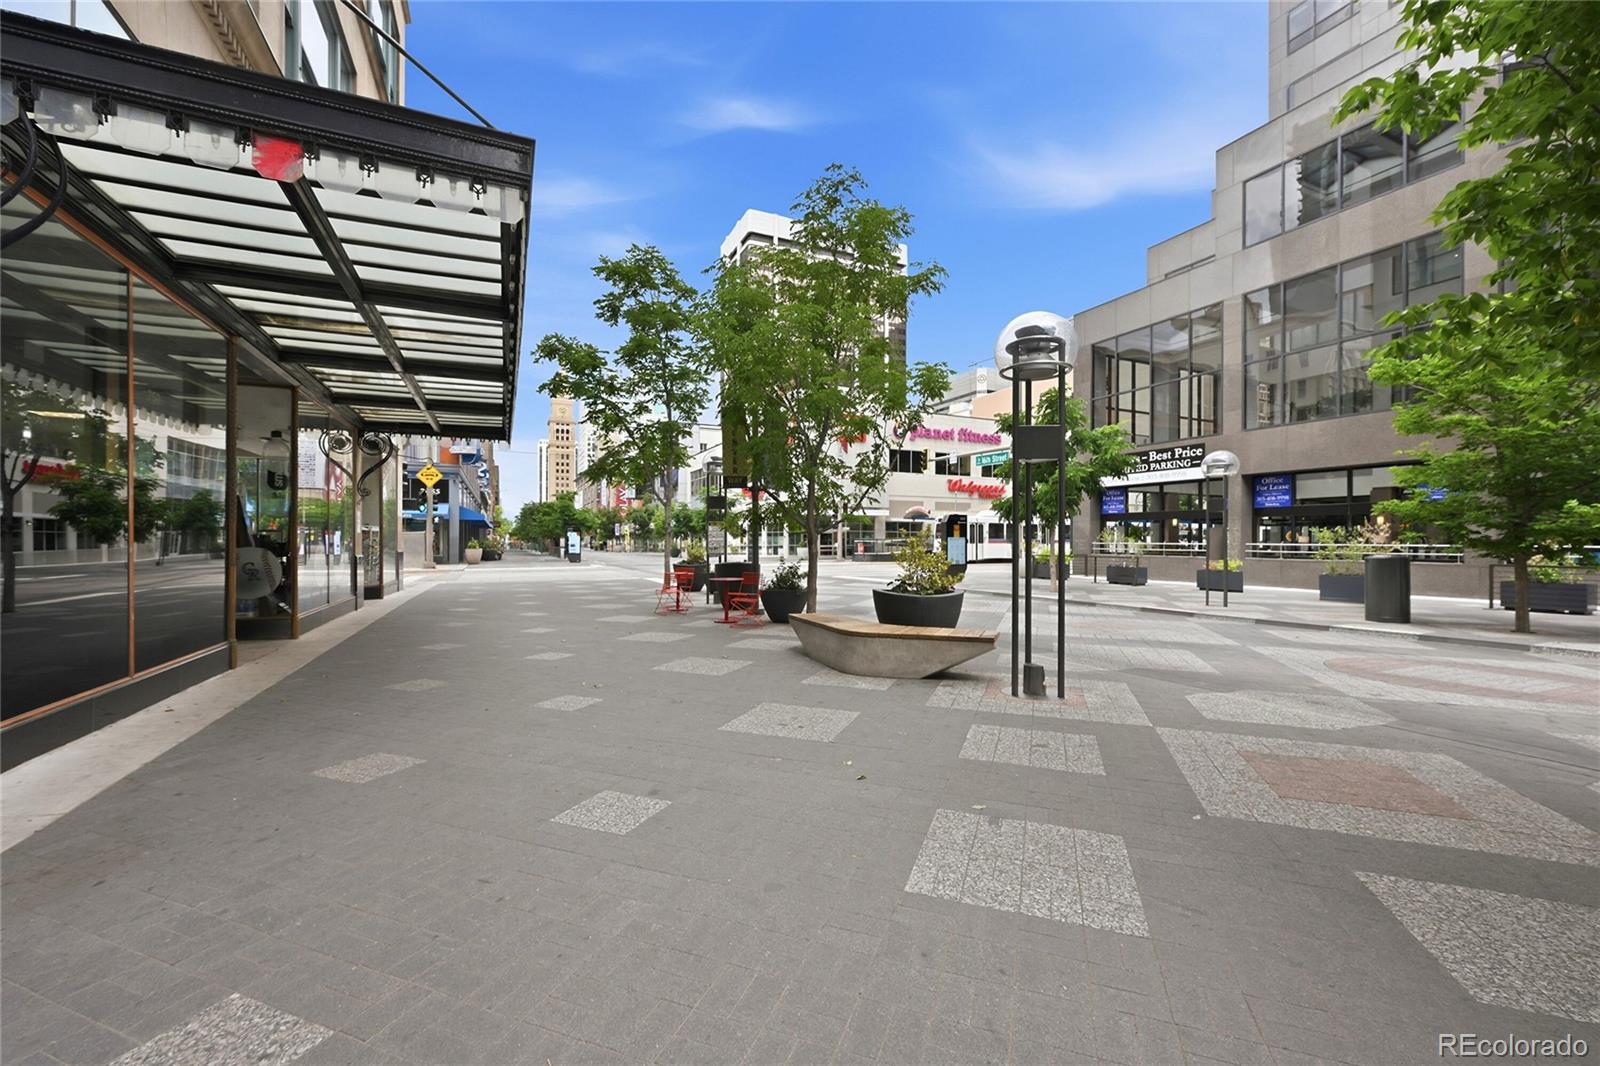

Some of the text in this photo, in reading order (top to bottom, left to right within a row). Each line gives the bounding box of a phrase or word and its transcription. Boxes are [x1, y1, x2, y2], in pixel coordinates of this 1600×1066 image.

[958, 428, 1001, 445] fitness
[992, 453, 1007, 463] Street
[1149, 451, 1172, 461] Best
[1174, 446, 1203, 458] Price
[1150, 459, 1191, 471] PARKING
[1261, 477, 1284, 485] Office
